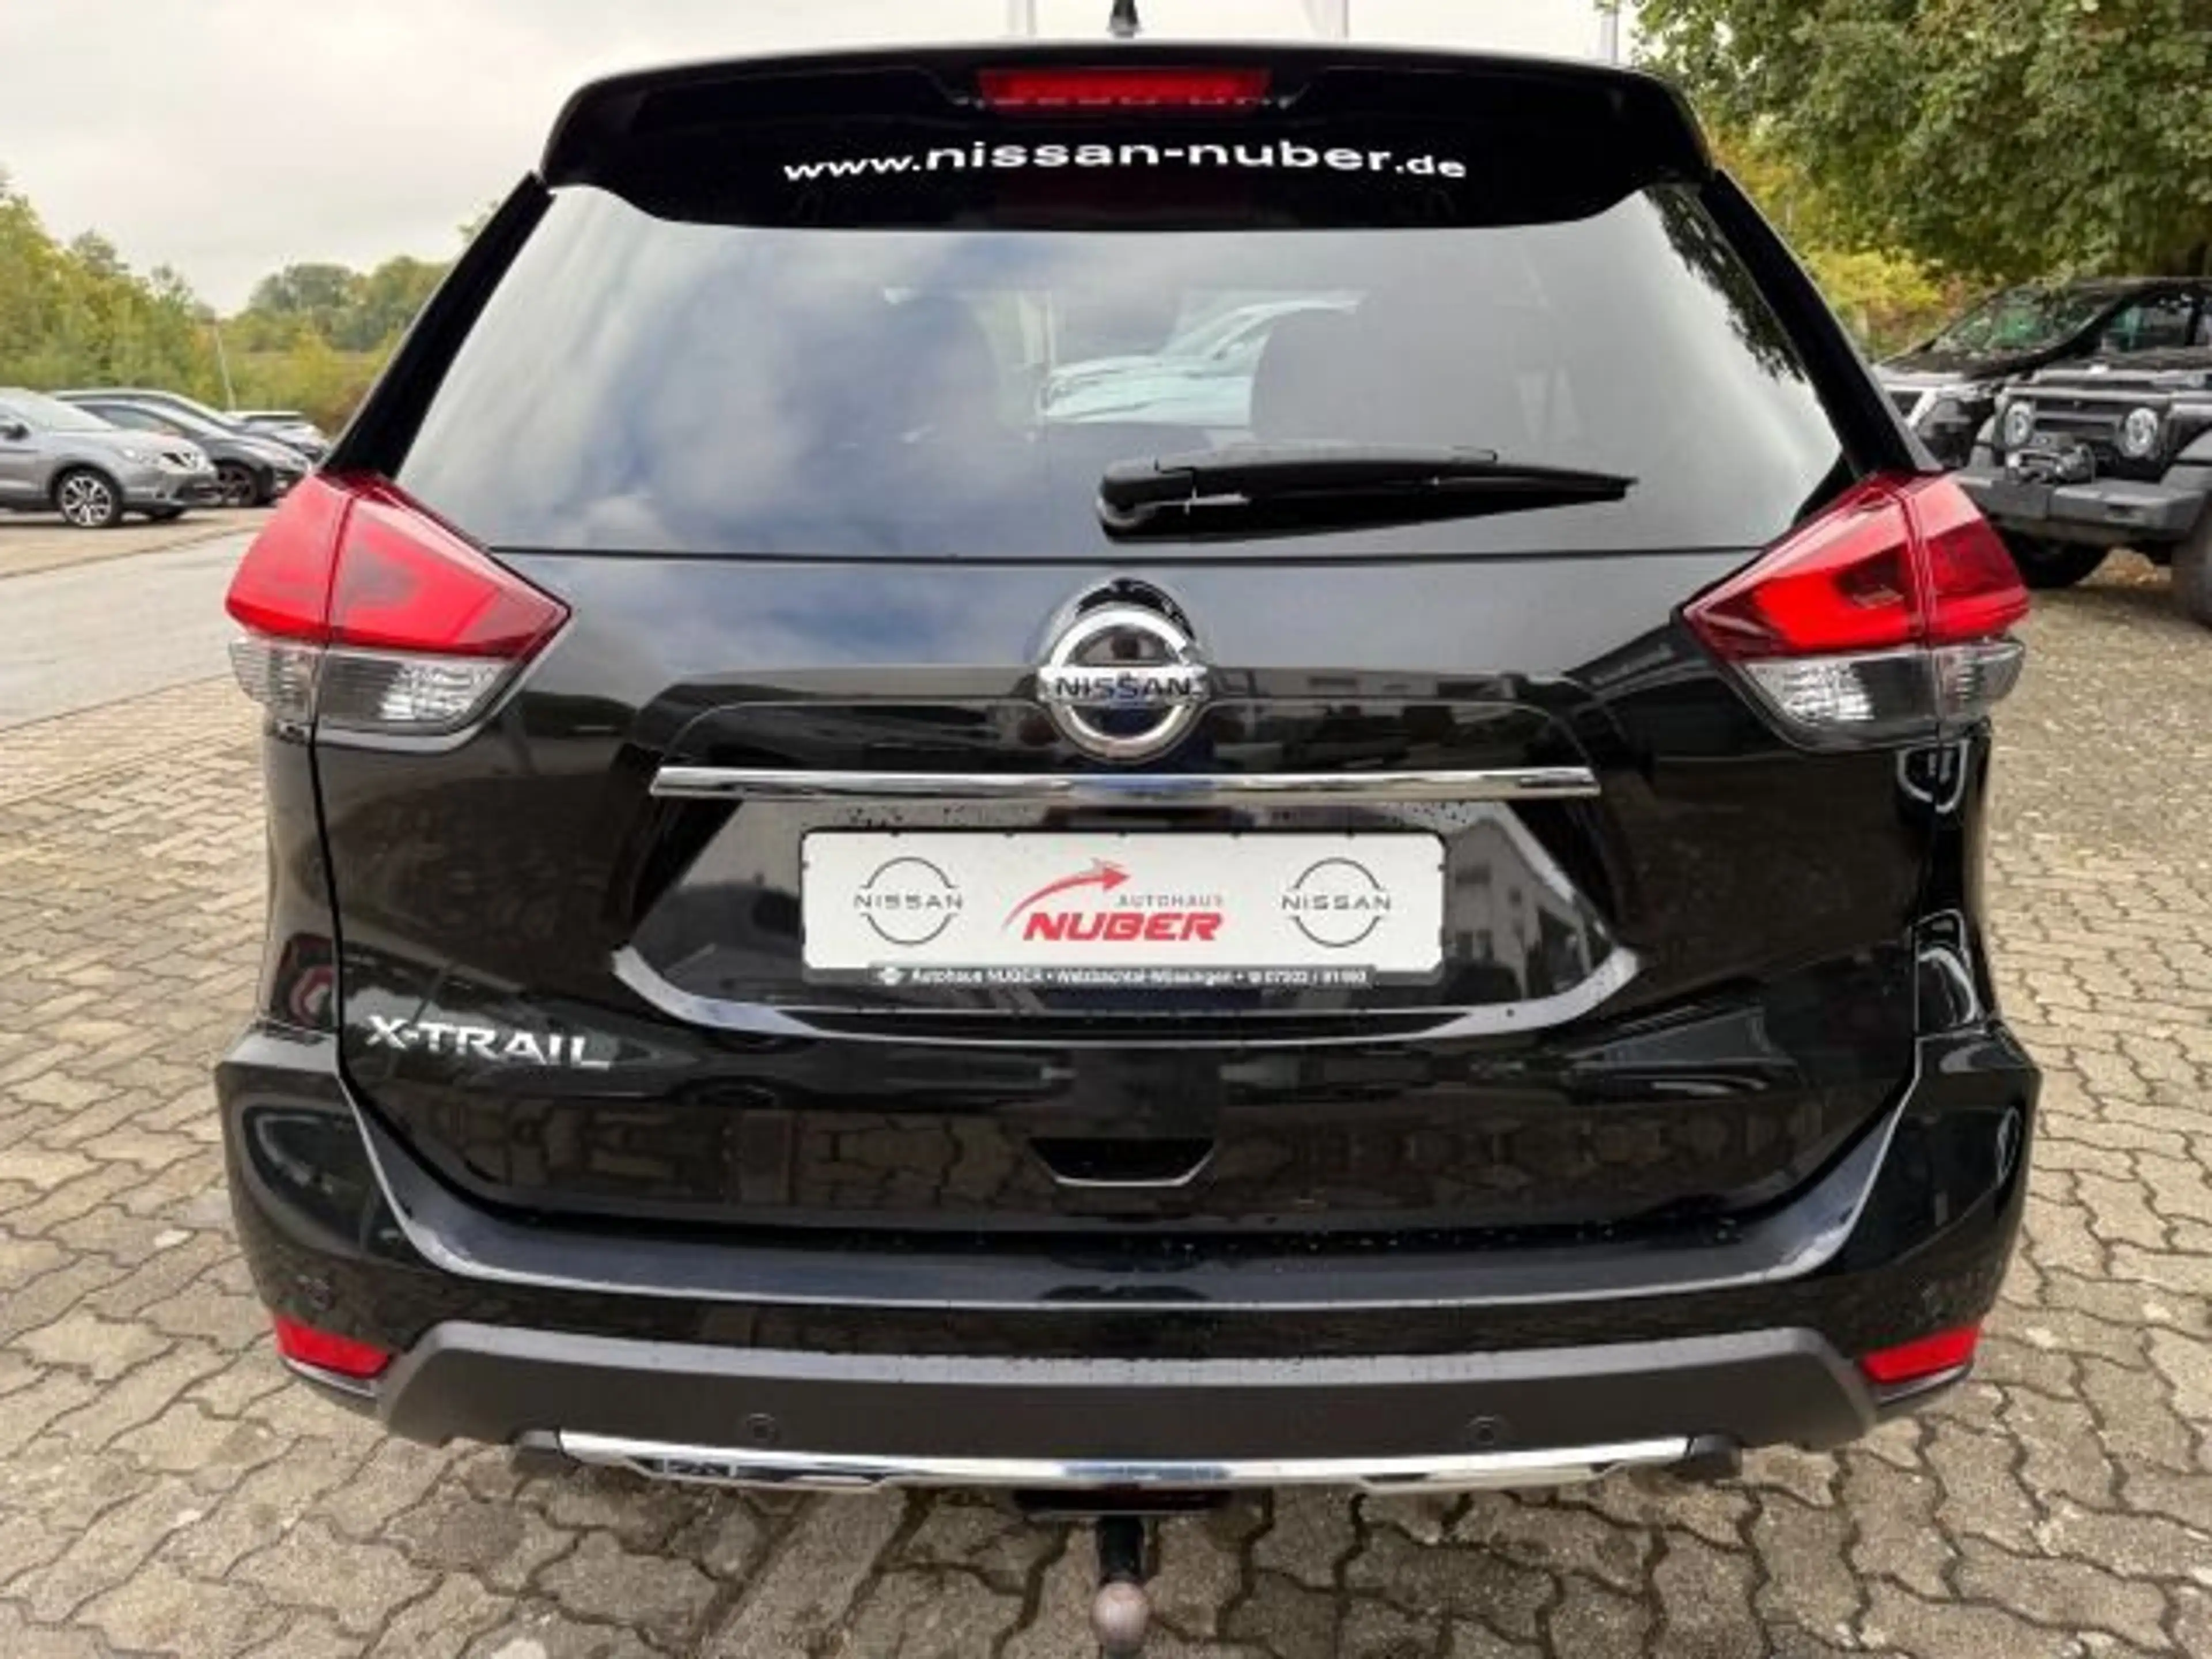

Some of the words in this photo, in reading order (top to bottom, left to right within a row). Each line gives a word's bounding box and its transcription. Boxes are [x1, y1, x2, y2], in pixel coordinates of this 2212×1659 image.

[783, 141, 1467, 180] www.nissan-nuber.de
[1056, 676, 1192, 698] NISSAN
[853, 894, 963, 910] NISSAN
[1116, 894, 1224, 907] AUTOHAUS
[1281, 894, 1391, 910] NISSAN
[1022, 912, 1224, 941] NUBER
[366, 1015, 610, 1070] X-TRAIL
